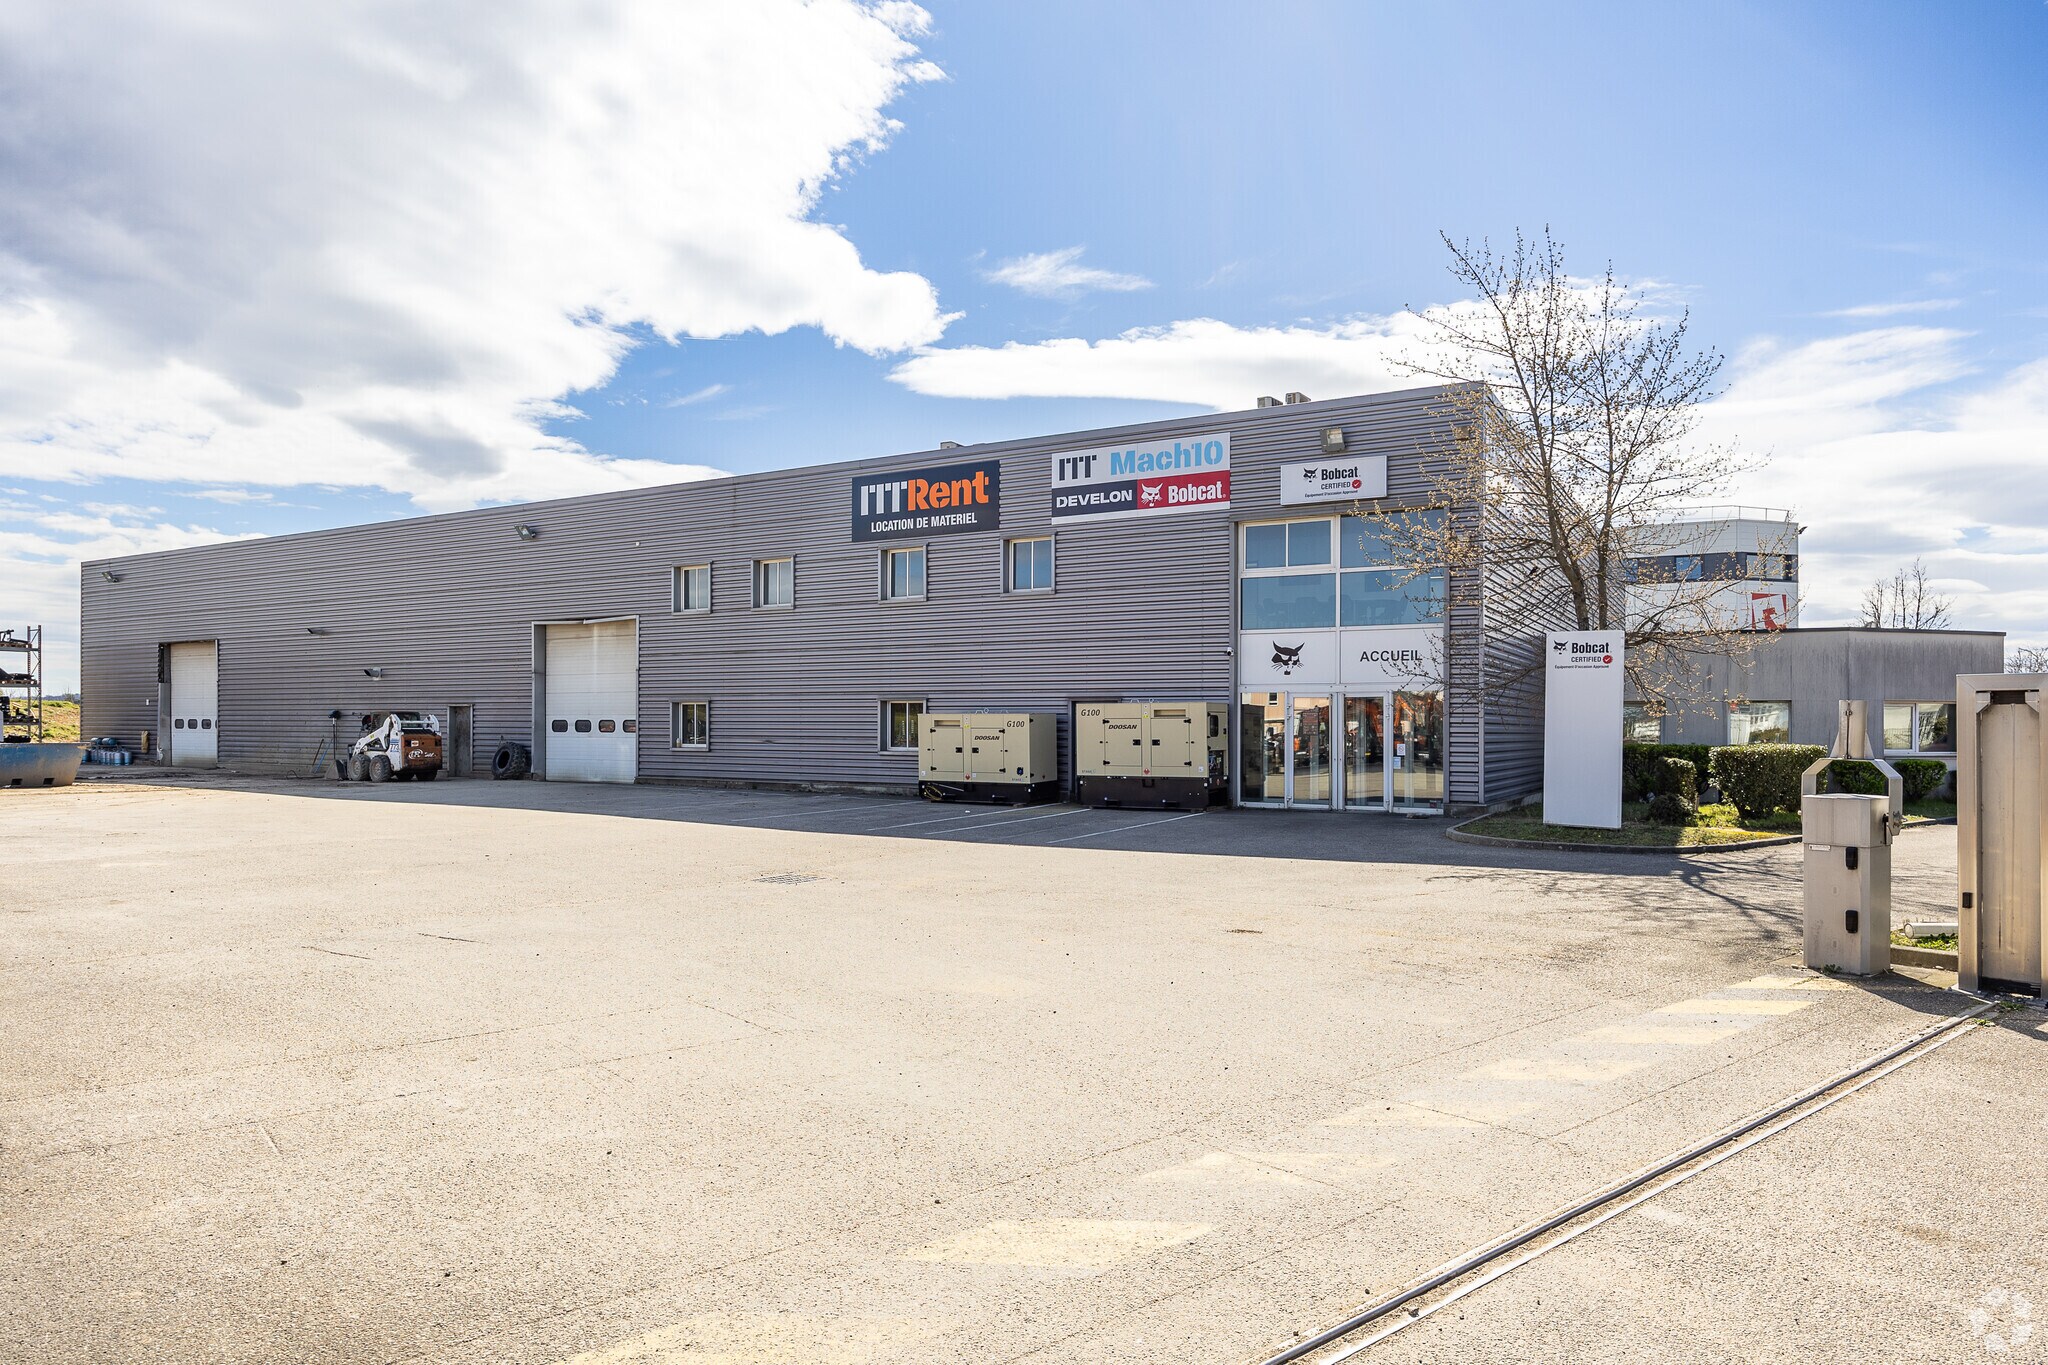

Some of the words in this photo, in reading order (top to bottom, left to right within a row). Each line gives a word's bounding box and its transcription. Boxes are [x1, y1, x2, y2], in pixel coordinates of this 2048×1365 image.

[1110, 440, 1223, 476] Mach10
[1321, 466, 1359, 480] Bobcat
[1321, 482, 1351, 490] CERTIFIED
[1056, 489, 1133, 508] DEVELON
[1168, 481, 1223, 504] Bobcat
[871, 518, 914, 533] LOCATION
[916, 516, 929, 528] DE
[931, 512, 978, 527] MATERIEL
[1571, 642, 1609, 653] Bobcat
[1360, 650, 1422, 662] ACCUEIL
[1006, 720, 1025, 728] G100
